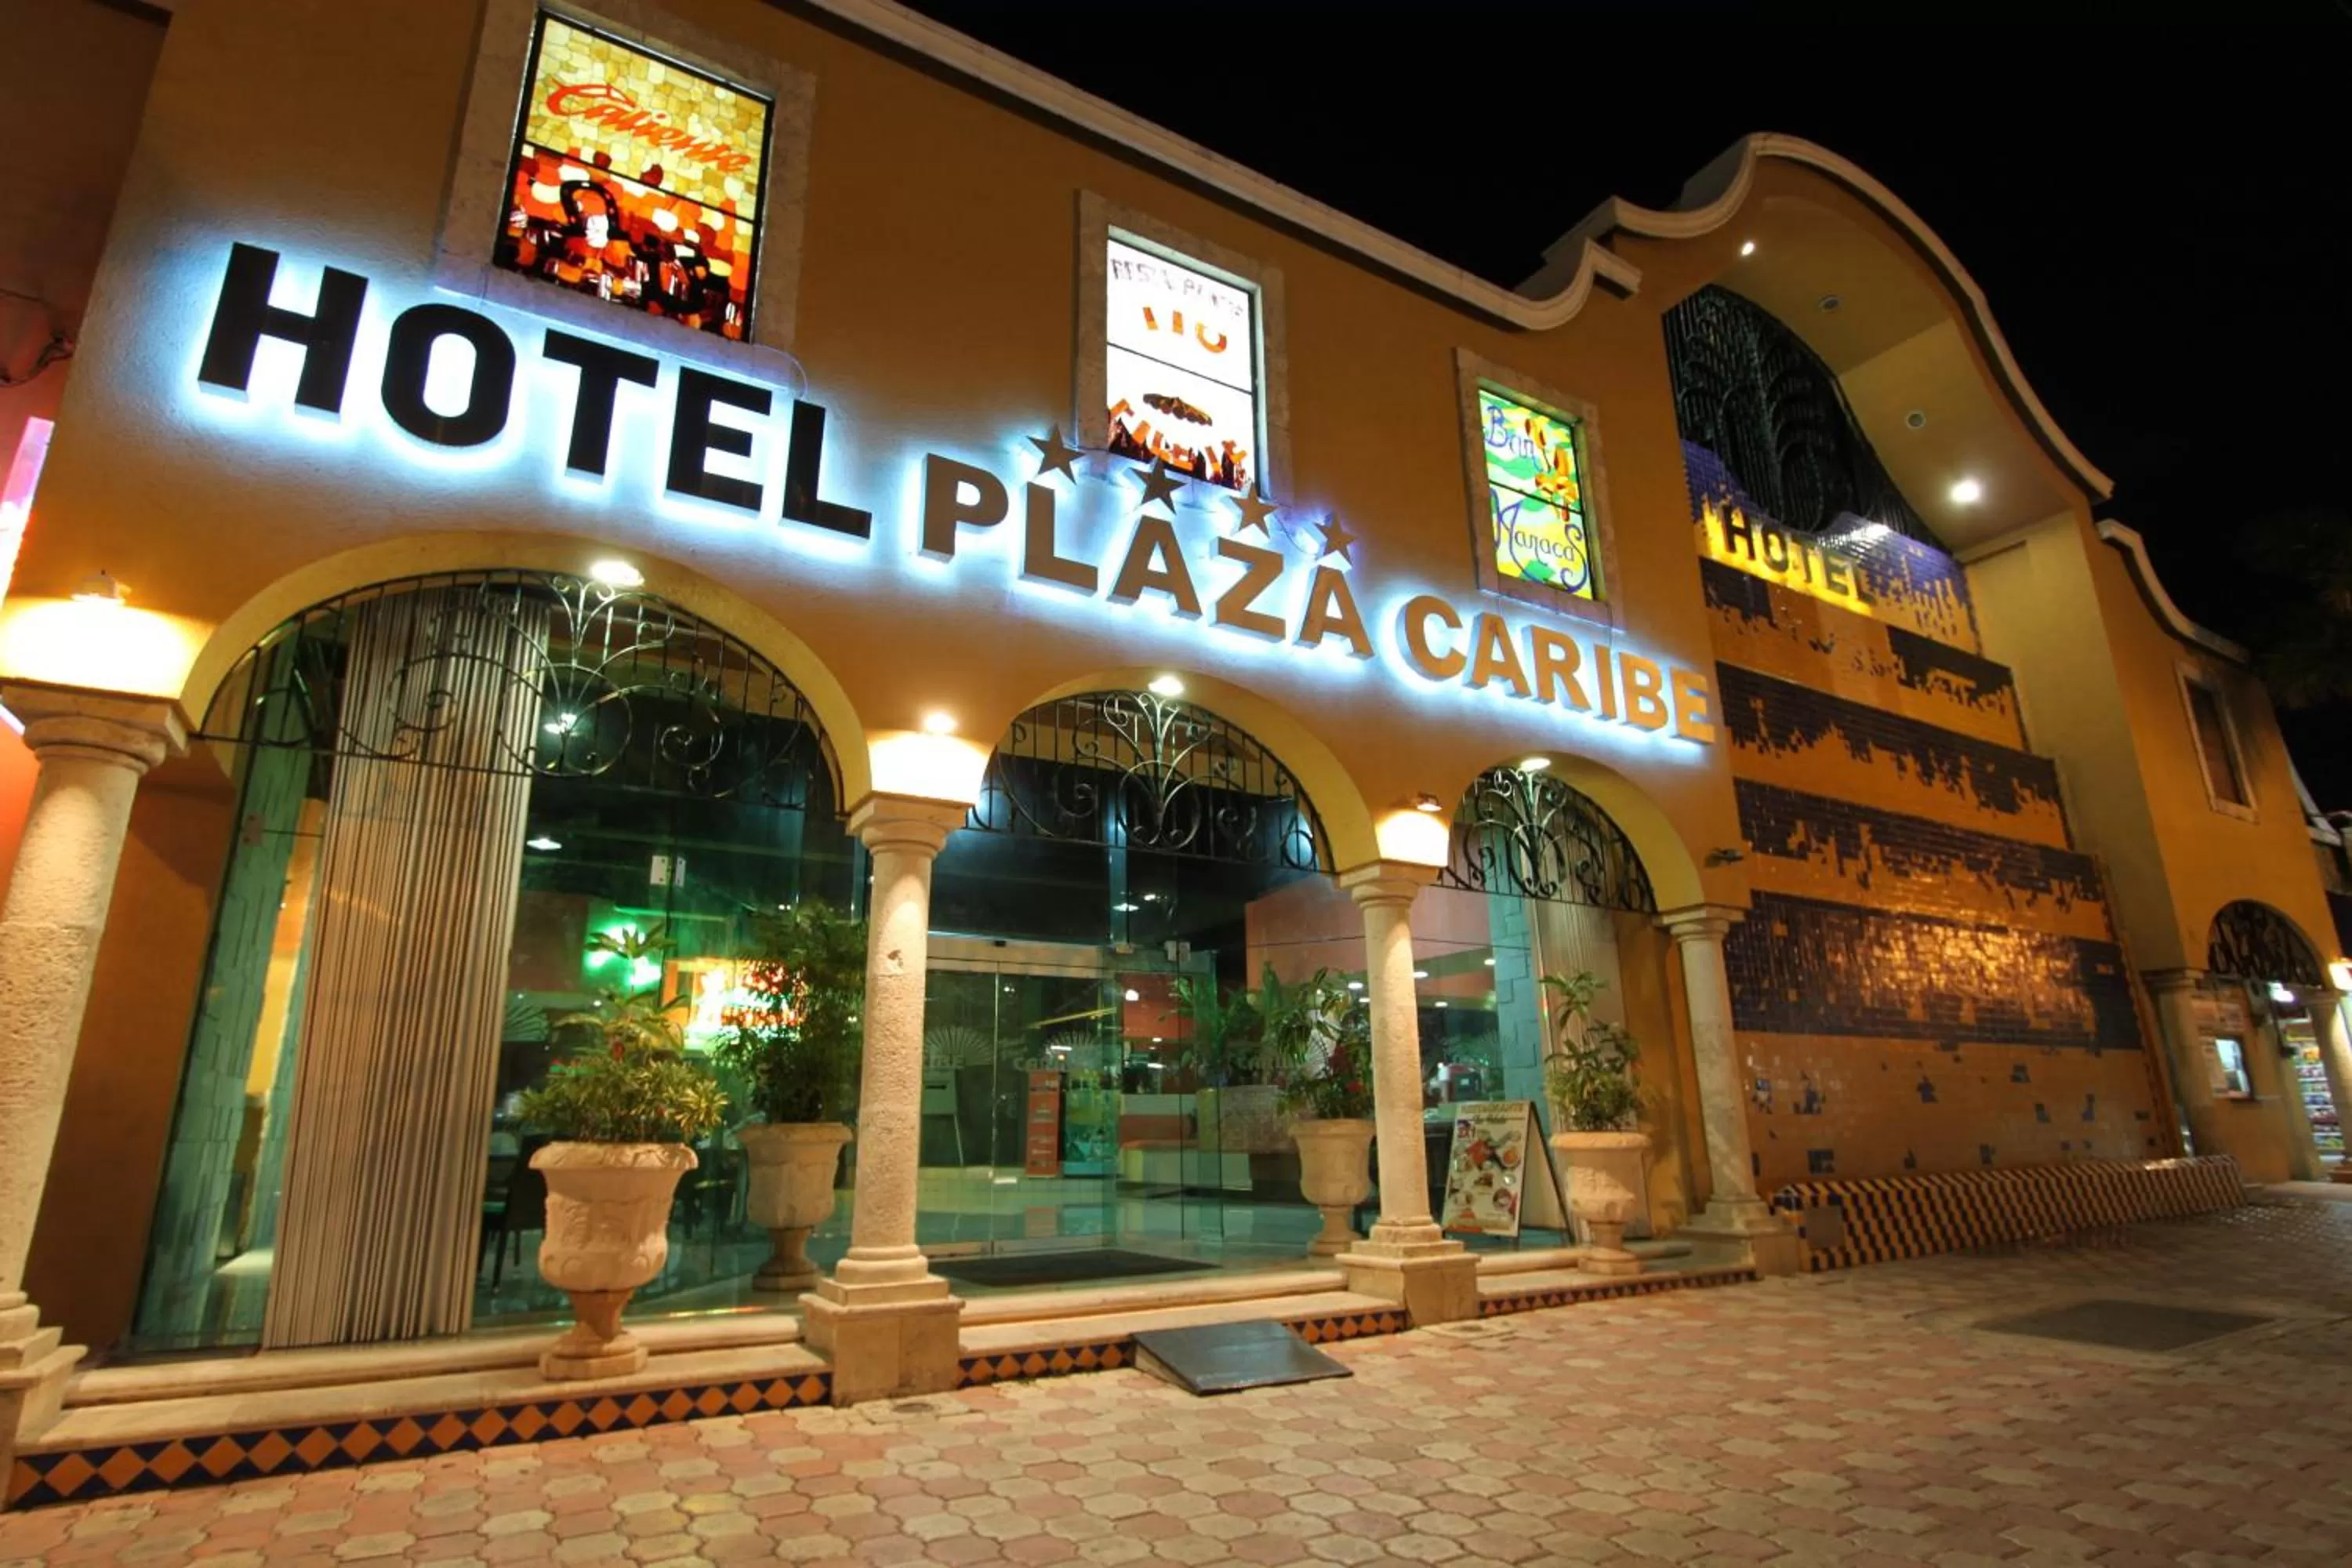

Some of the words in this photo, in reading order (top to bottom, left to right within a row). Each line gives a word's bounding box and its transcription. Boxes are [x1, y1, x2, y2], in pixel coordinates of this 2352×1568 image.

[546, 75, 752, 173] Caliente
[198, 241, 873, 543] HOTEL
[920, 452, 1374, 659] PLAZA
[1396, 594, 1717, 746] CARIBE
[1721, 503, 1878, 608] HOTEL
